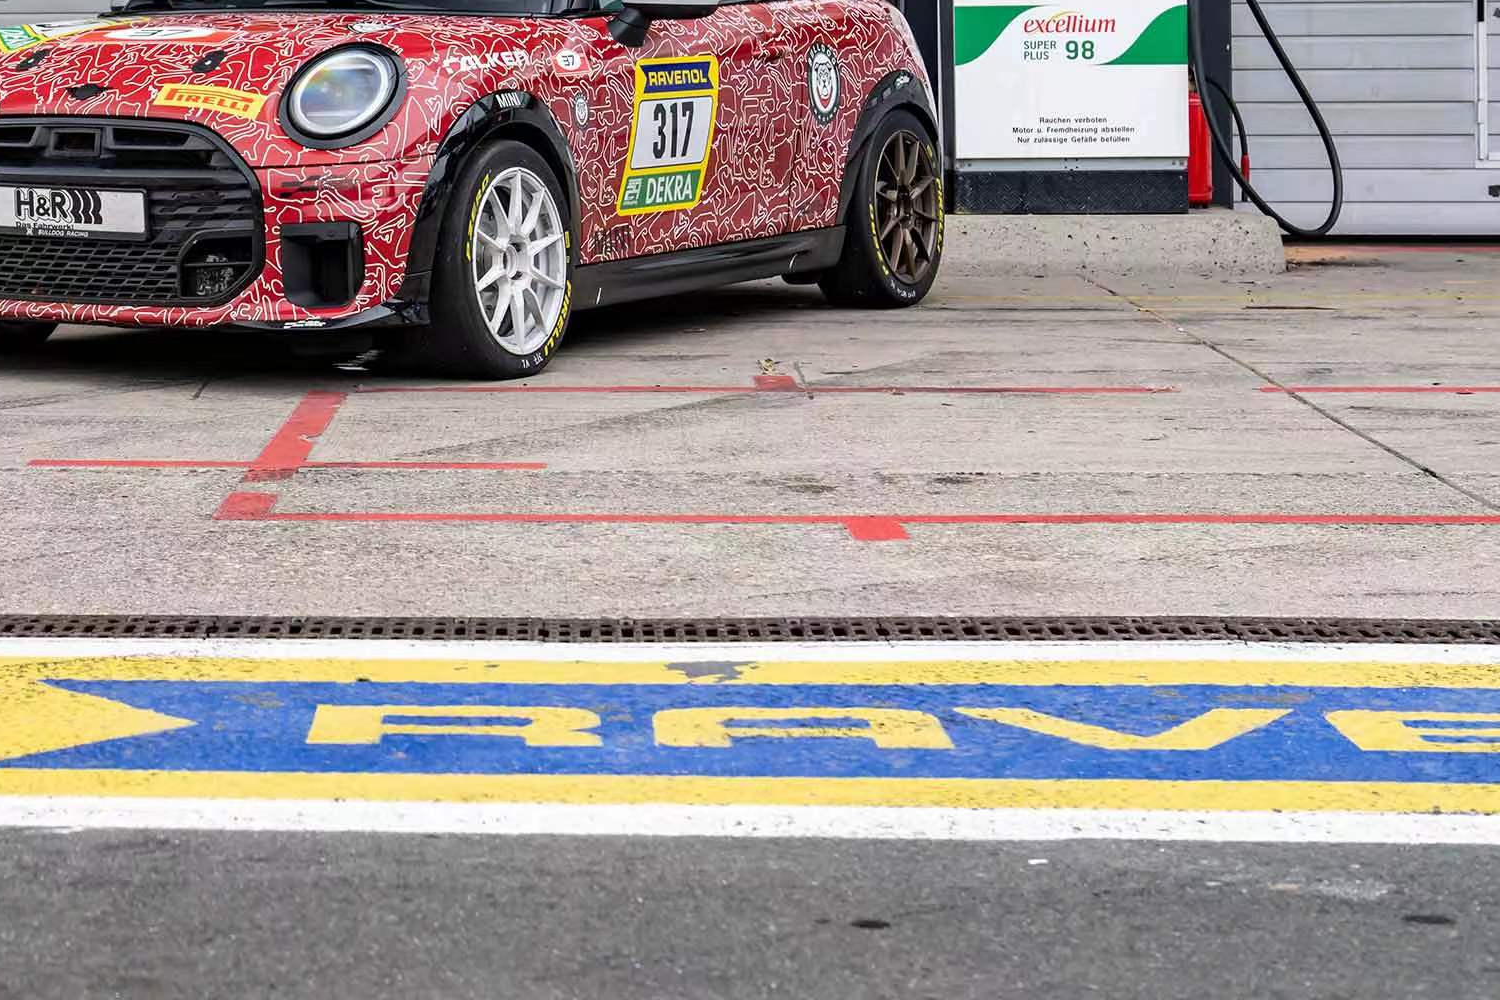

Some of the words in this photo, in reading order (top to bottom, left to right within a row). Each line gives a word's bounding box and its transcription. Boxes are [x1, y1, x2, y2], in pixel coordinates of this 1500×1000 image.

[1024, 11, 1116, 34] excellium
[1024, 40, 1057, 50] SUPER
[1065, 40, 1095, 60] 98
[561, 54, 575, 67] 37
[1024, 51, 1050, 61] PLUS
[648, 69, 707, 87] RAVENOL
[163, 87, 256, 113] PIRELLI
[496, 92, 522, 109] MINI
[652, 101, 694, 159] 317
[1046, 127, 1098, 135] Fremdheizung
[1101, 126, 1135, 134] abstellen
[1017, 136, 1030, 144] Nur
[645, 173, 693, 204] DEKRA
[16, 189, 68, 219] H&R
[38, 229, 64, 237] BULLDOG
